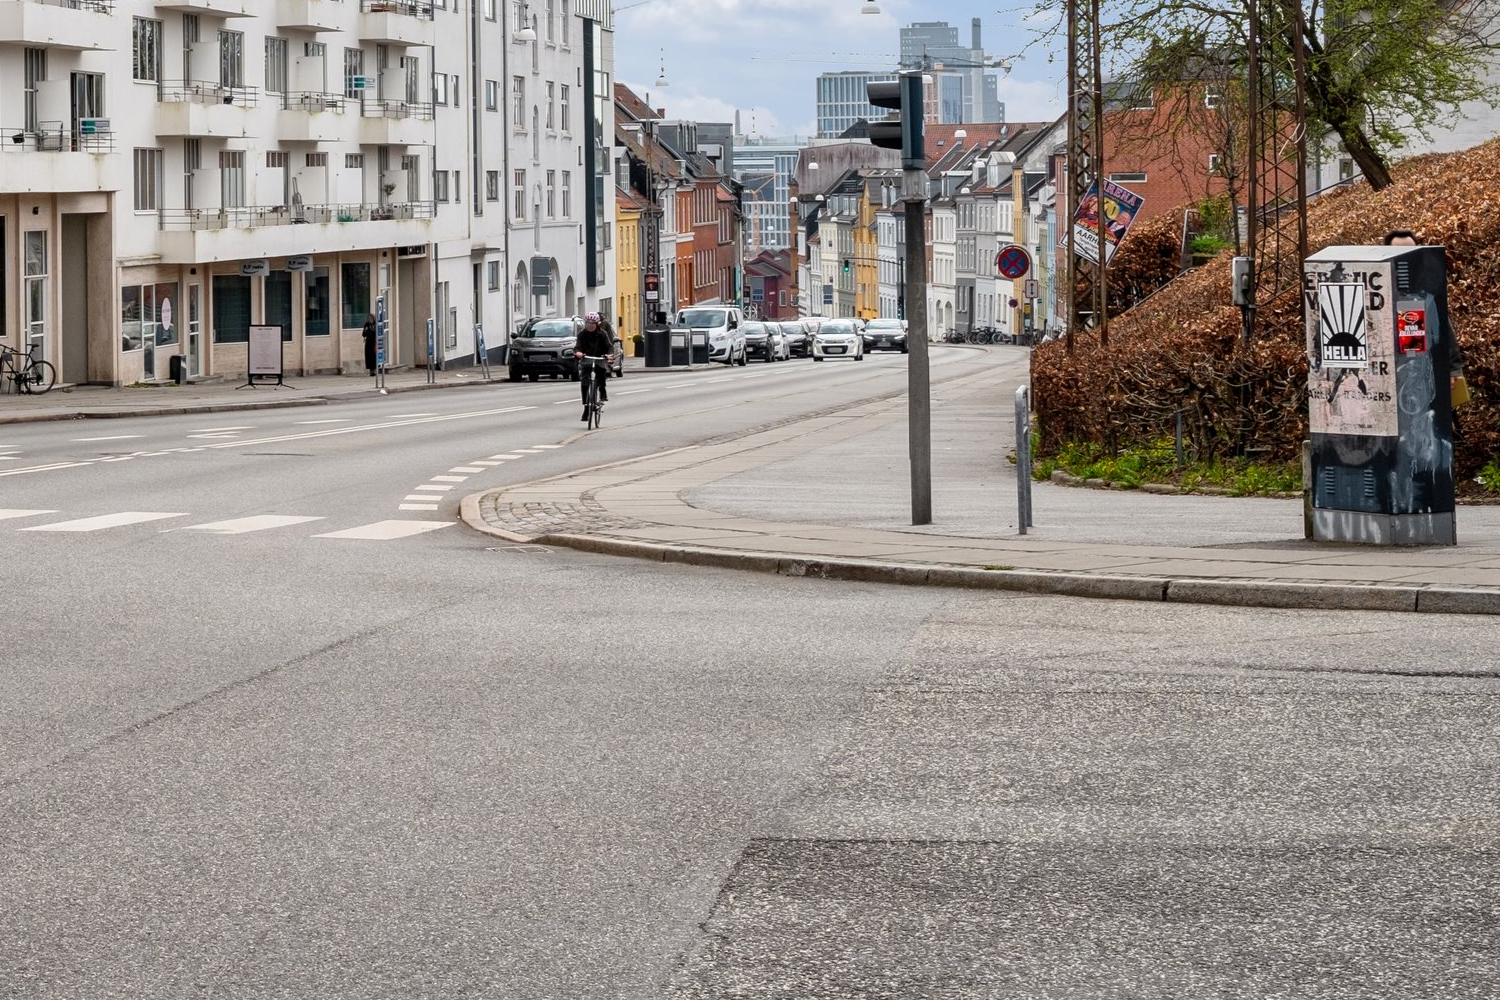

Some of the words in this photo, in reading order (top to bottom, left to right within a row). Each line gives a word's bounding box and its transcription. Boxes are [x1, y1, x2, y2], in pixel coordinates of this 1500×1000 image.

[1076, 228, 1102, 246] AARH
[1304, 271, 1384, 291] ERTIC
[1323, 345, 1366, 361] HELLA
